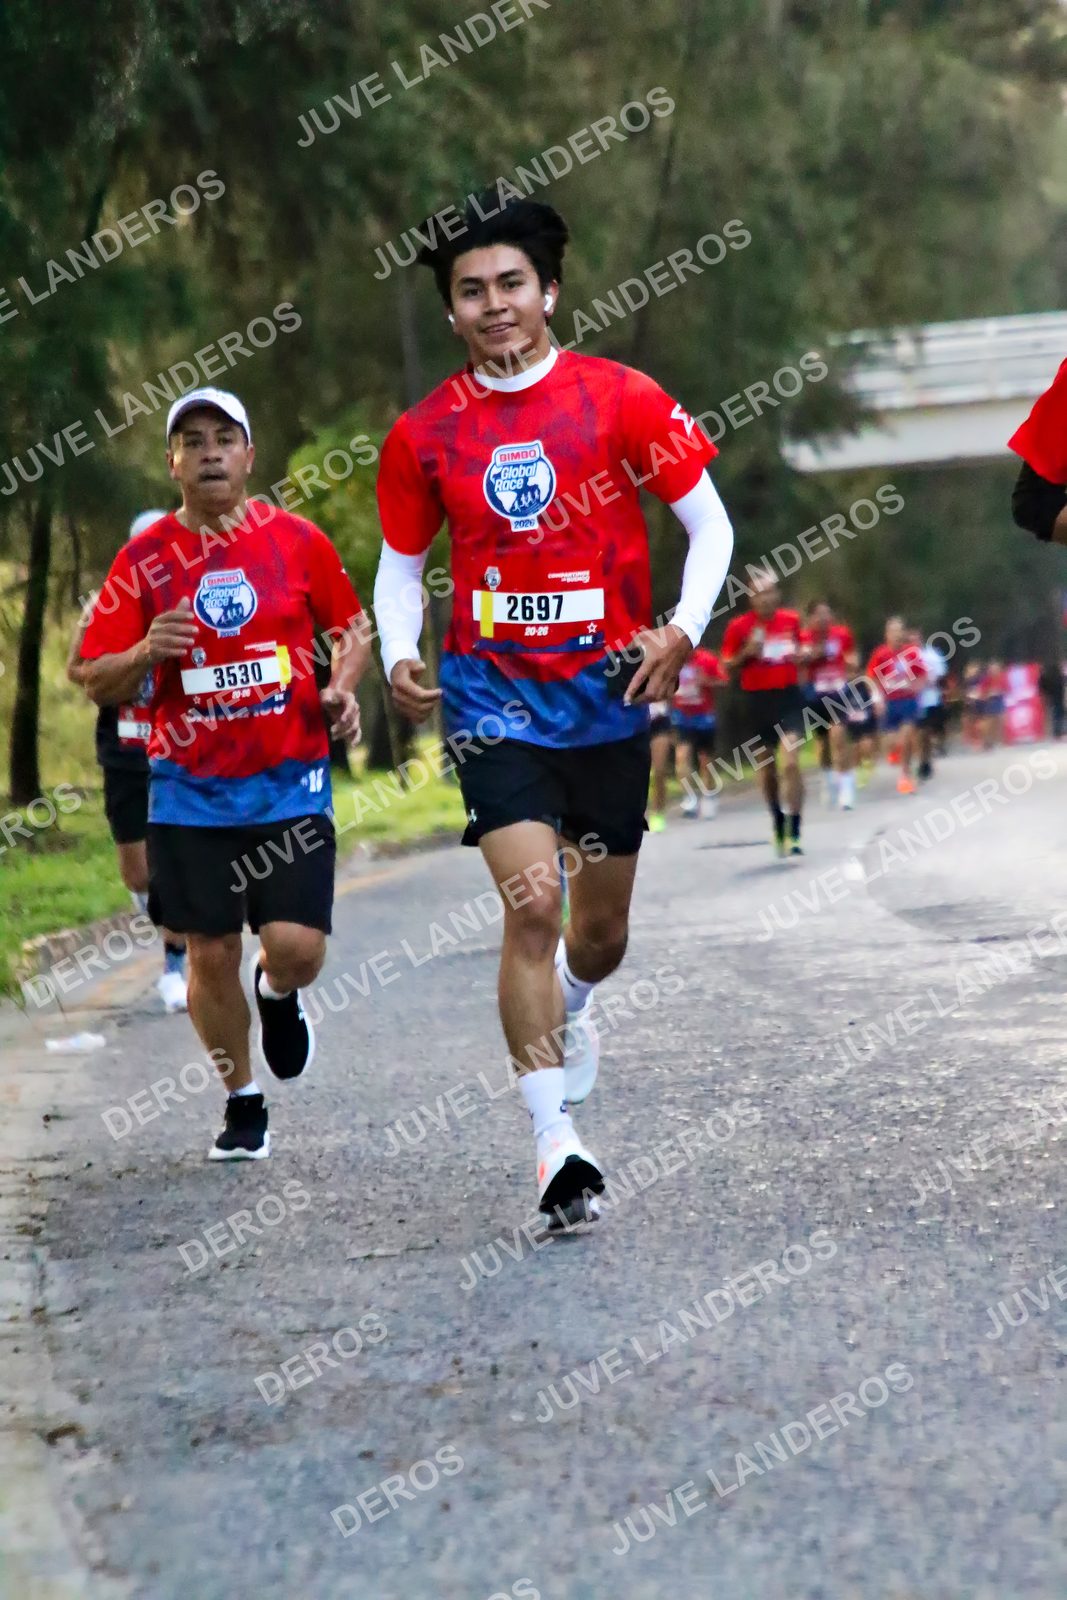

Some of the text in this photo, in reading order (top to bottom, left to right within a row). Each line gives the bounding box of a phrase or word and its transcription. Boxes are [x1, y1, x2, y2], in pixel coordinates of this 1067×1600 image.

[499, 449, 537, 462] BIMBO
[500, 463, 537, 479] Global
[494, 479, 524, 492] Race
[506, 594, 564, 621] 2697
[213, 661, 263, 689] 3530
